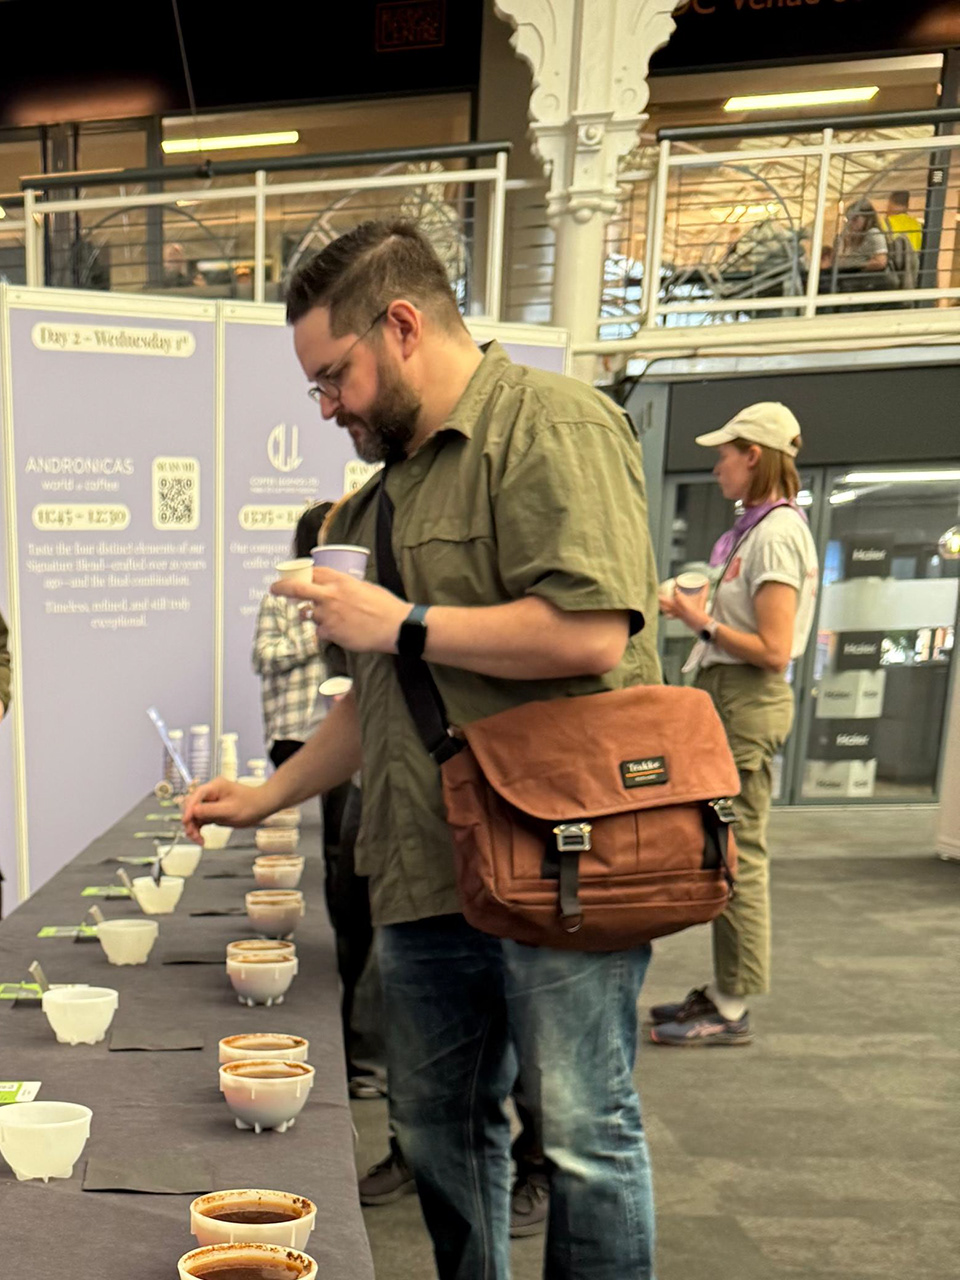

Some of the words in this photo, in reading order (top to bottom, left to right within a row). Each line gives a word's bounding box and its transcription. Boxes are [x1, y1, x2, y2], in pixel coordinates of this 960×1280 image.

[40, 327, 68, 348] Day
[73, 333, 81, 345] 2
[94, 330, 171, 354] Wednesday
[25, 456, 134, 474] ANDRONICAS
